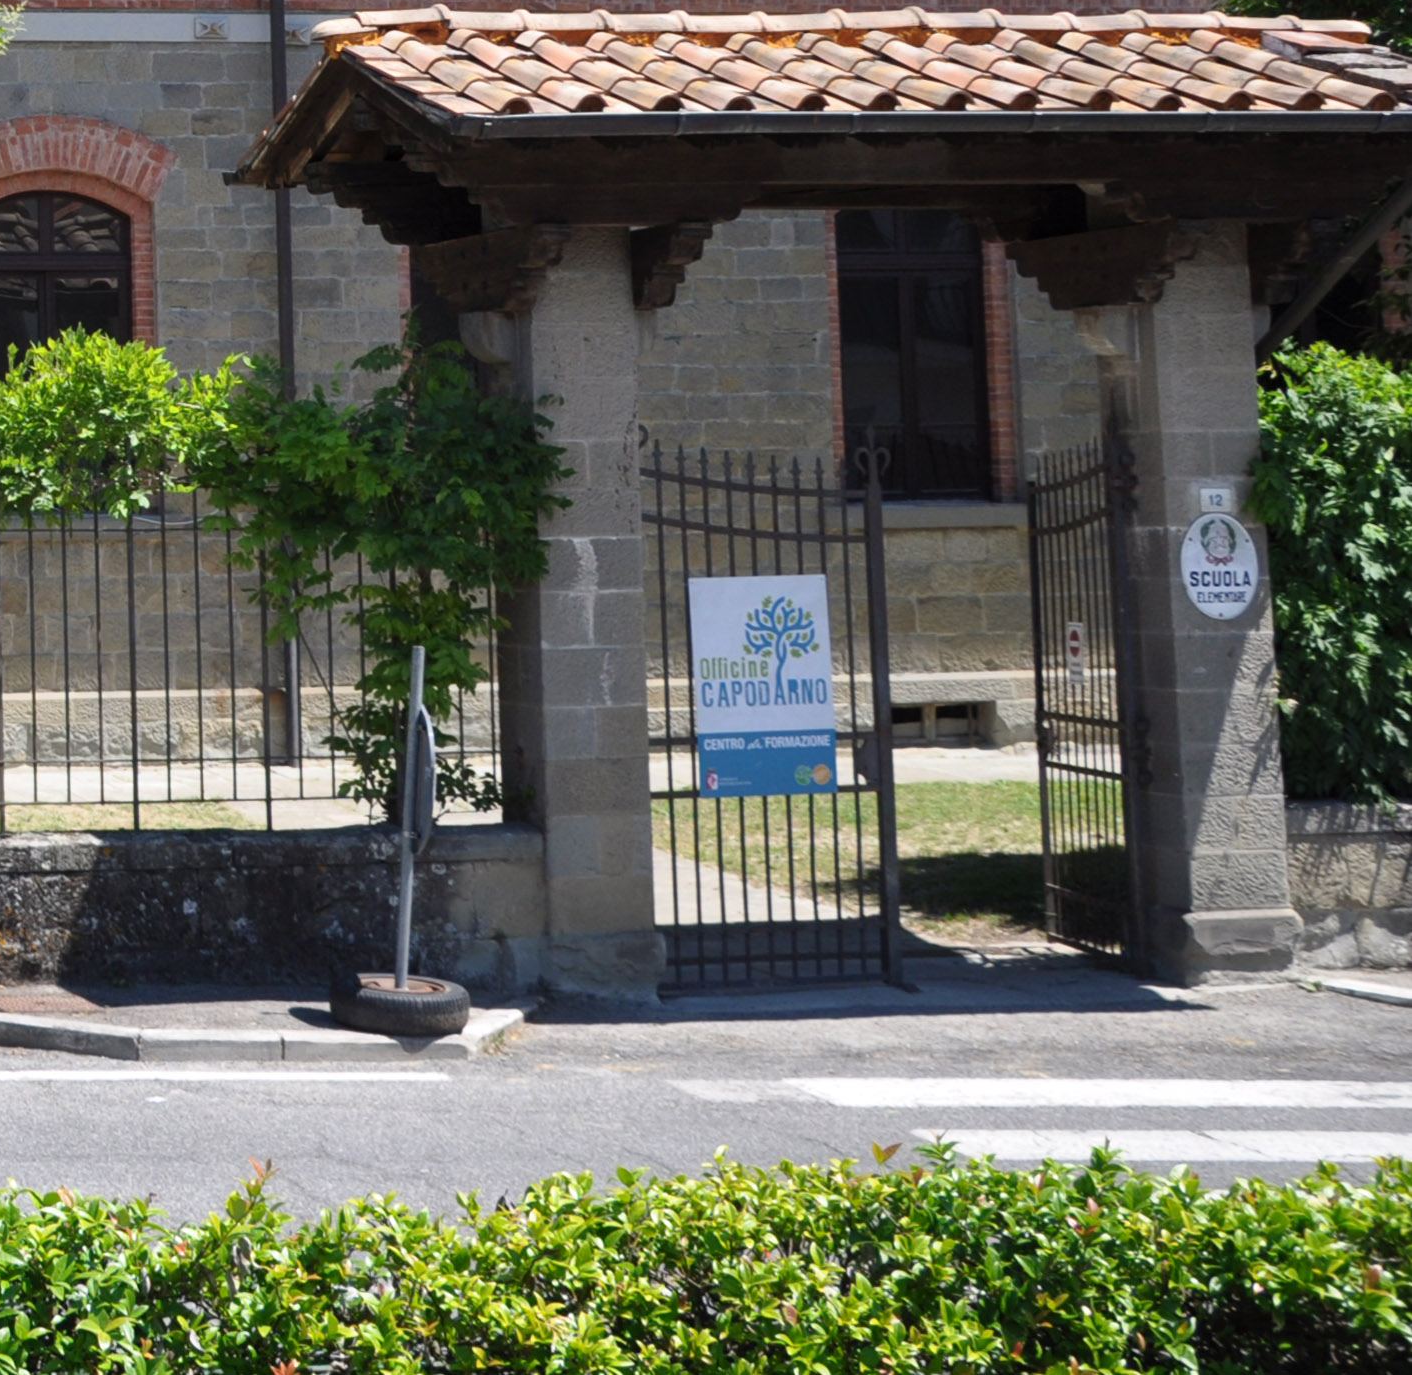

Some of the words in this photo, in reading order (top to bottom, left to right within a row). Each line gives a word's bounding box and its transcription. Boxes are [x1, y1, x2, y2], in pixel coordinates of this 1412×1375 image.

[1208, 494, 1224, 507] 12
[1189, 570, 1252, 588] SCUOLA
[1196, 591, 1247, 604] ELEMENTARE
[700, 657, 769, 680] Officine
[701, 678, 828, 708] CAPODARNO
[703, 737, 745, 751] CENTRO
[765, 734, 831, 748] FORMAZIONE
